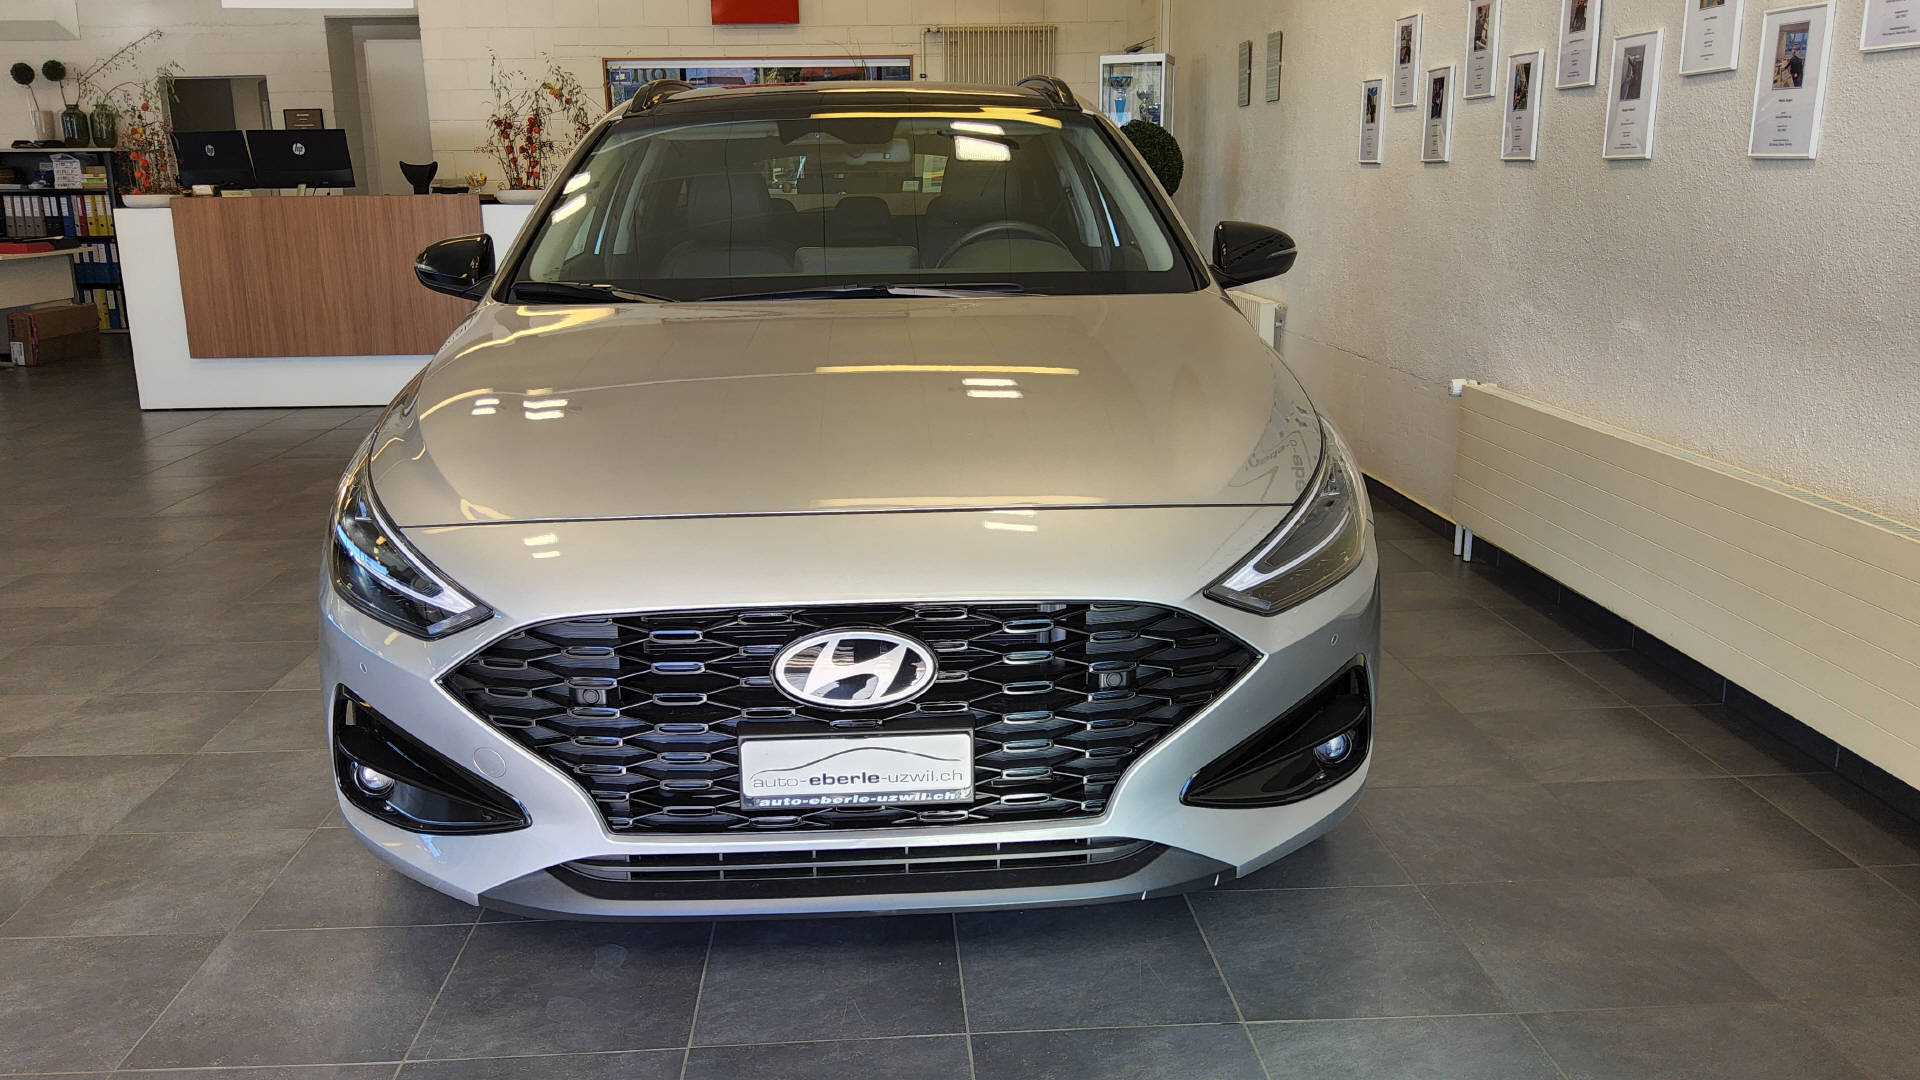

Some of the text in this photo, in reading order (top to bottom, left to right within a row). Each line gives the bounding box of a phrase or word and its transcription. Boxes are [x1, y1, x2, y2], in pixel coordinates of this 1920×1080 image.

[205, 144, 215, 157] hp
[293, 142, 305, 156] hp
[752, 769, 963, 788] auto-eberle-uzwil.ch
[759, 791, 956, 807] auto-eberle-uzwil.ch
